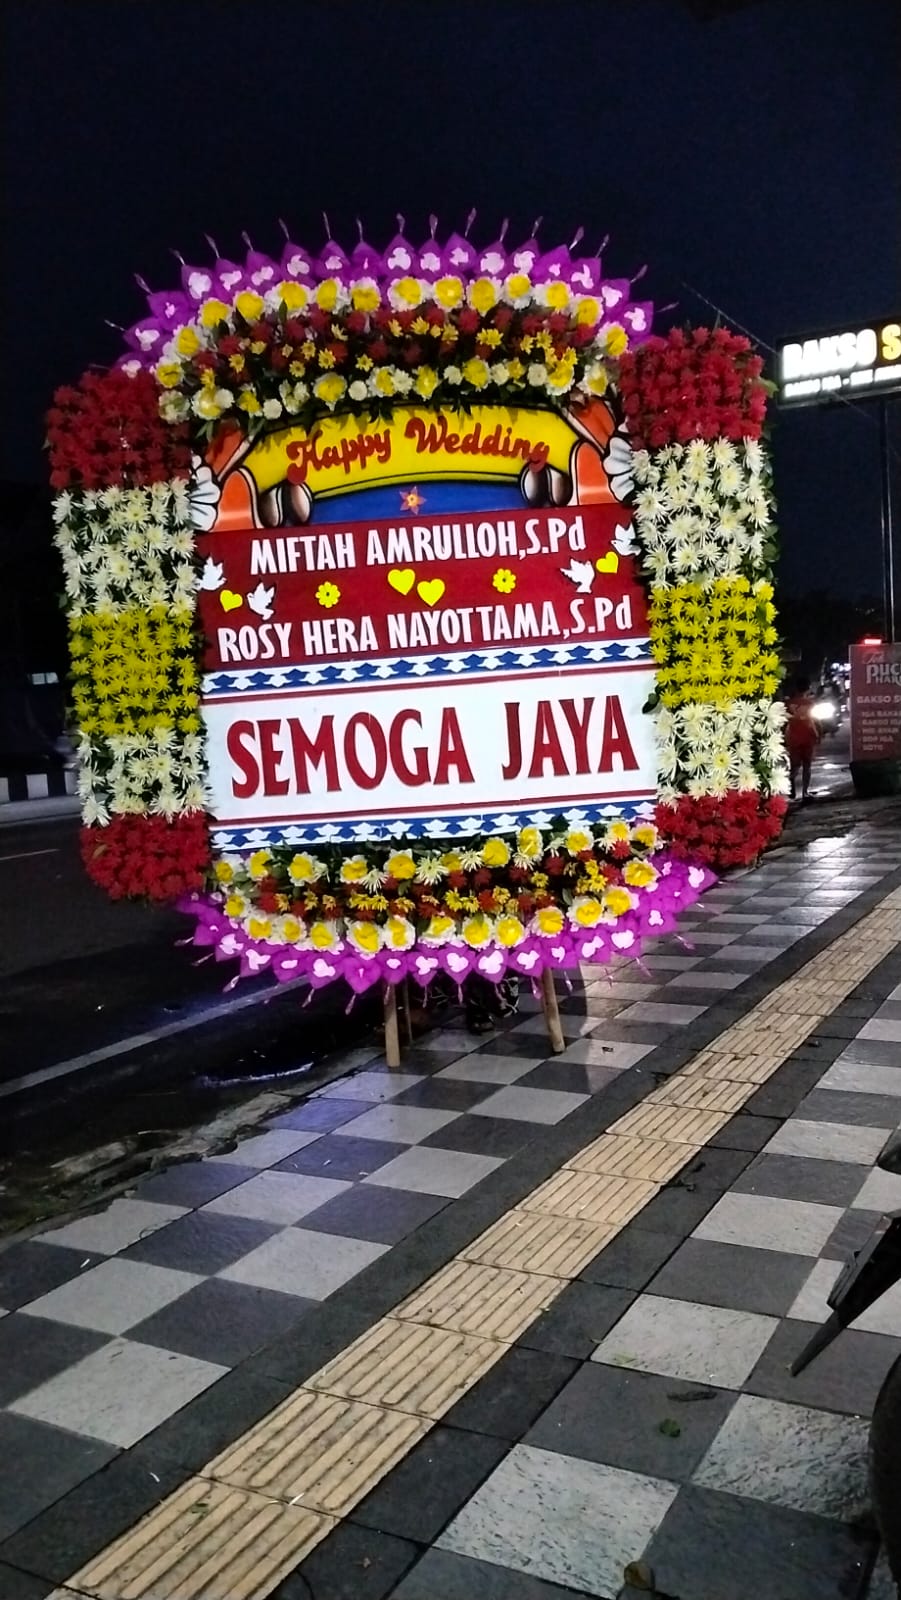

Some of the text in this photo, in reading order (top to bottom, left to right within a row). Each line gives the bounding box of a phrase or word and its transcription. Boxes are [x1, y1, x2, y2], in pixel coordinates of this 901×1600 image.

[286, 415, 550, 485] Happy Wedding
[250, 529, 356, 575] MIFTAH
[217, 622, 292, 663] ROSY
[302, 615, 378, 656] HERA
[866, 664, 901, 685] PUC
[226, 694, 640, 799] SEMOGA JAYA
